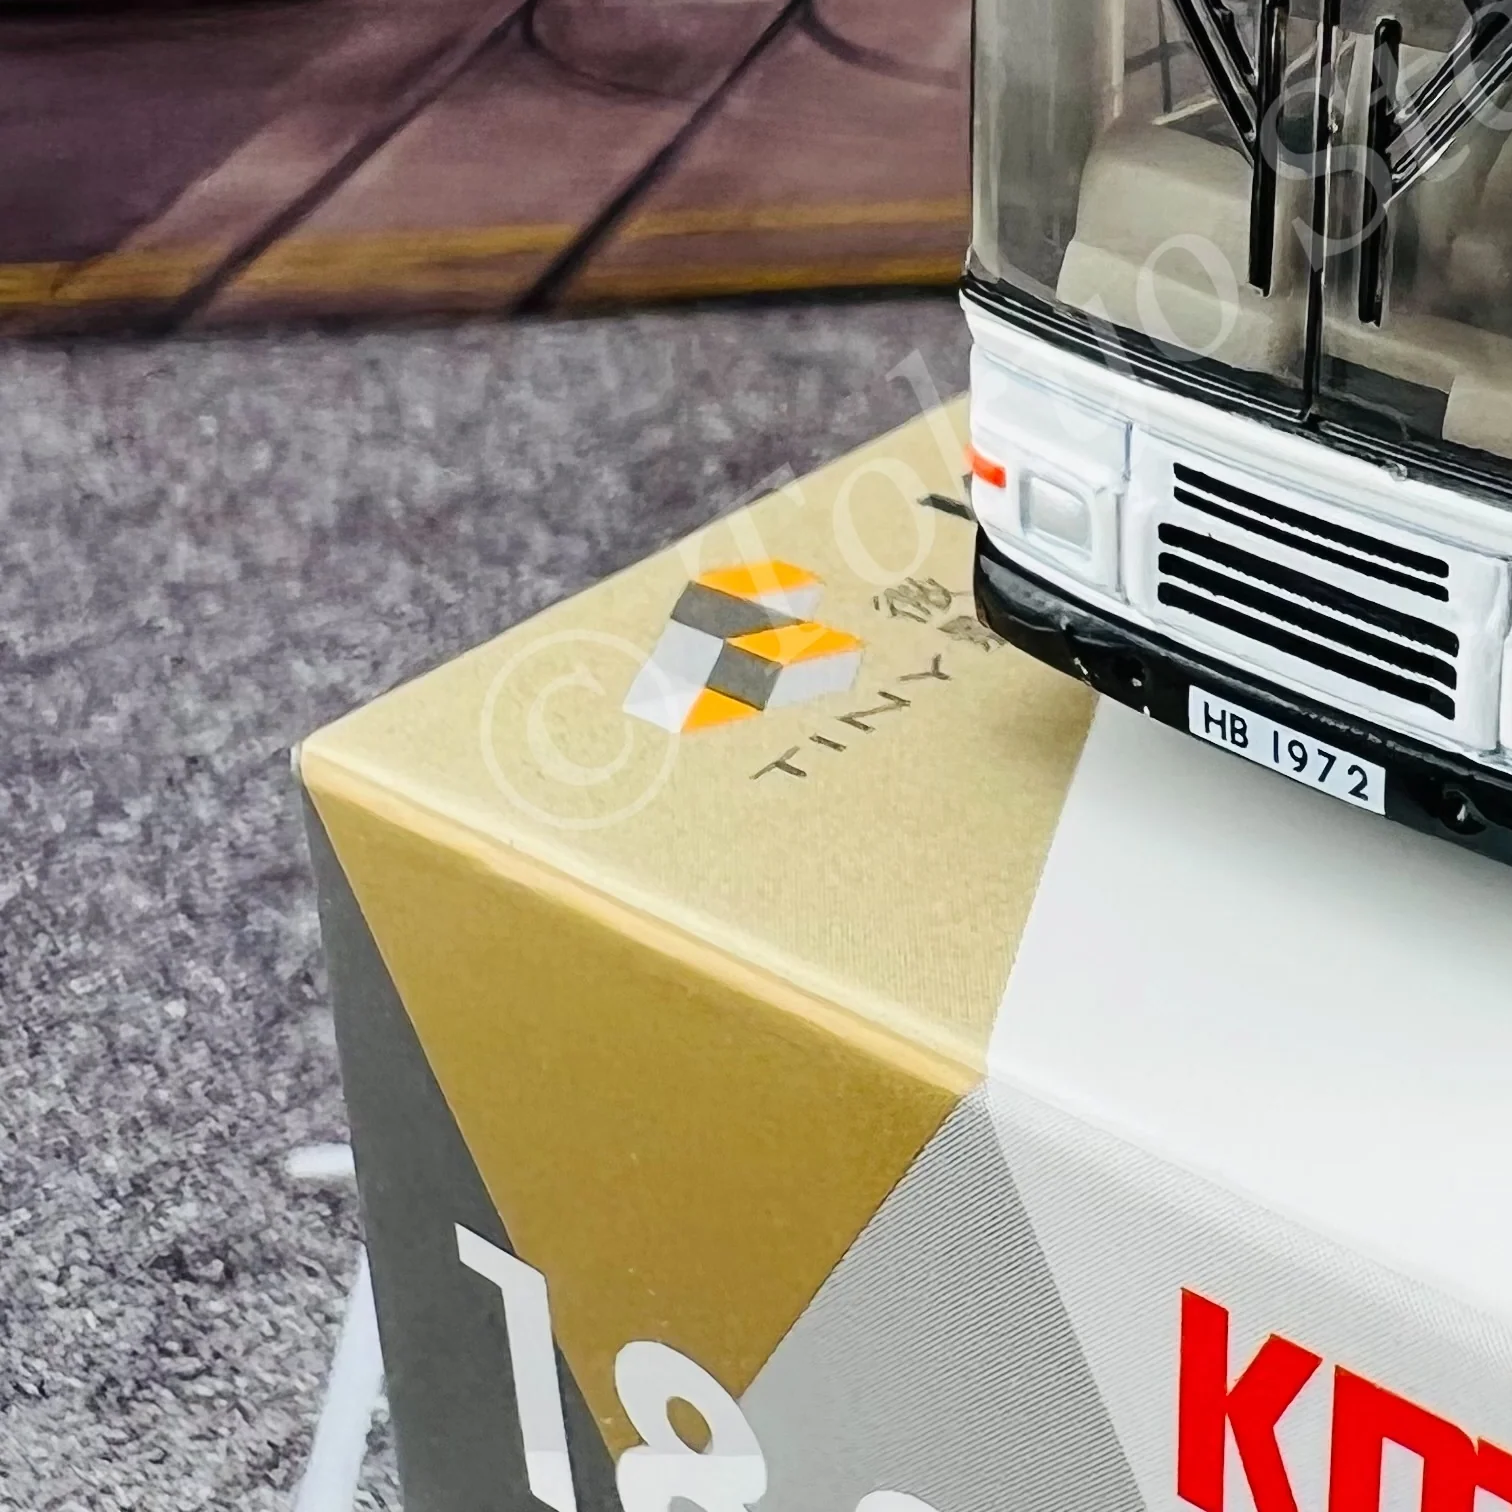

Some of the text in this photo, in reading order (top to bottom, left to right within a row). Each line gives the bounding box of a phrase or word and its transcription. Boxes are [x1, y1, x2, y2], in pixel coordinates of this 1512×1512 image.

[748, 652, 953, 780] TINY
[1203, 700, 1369, 802] HB 1972
[454, 1223, 944, 1512] 18
